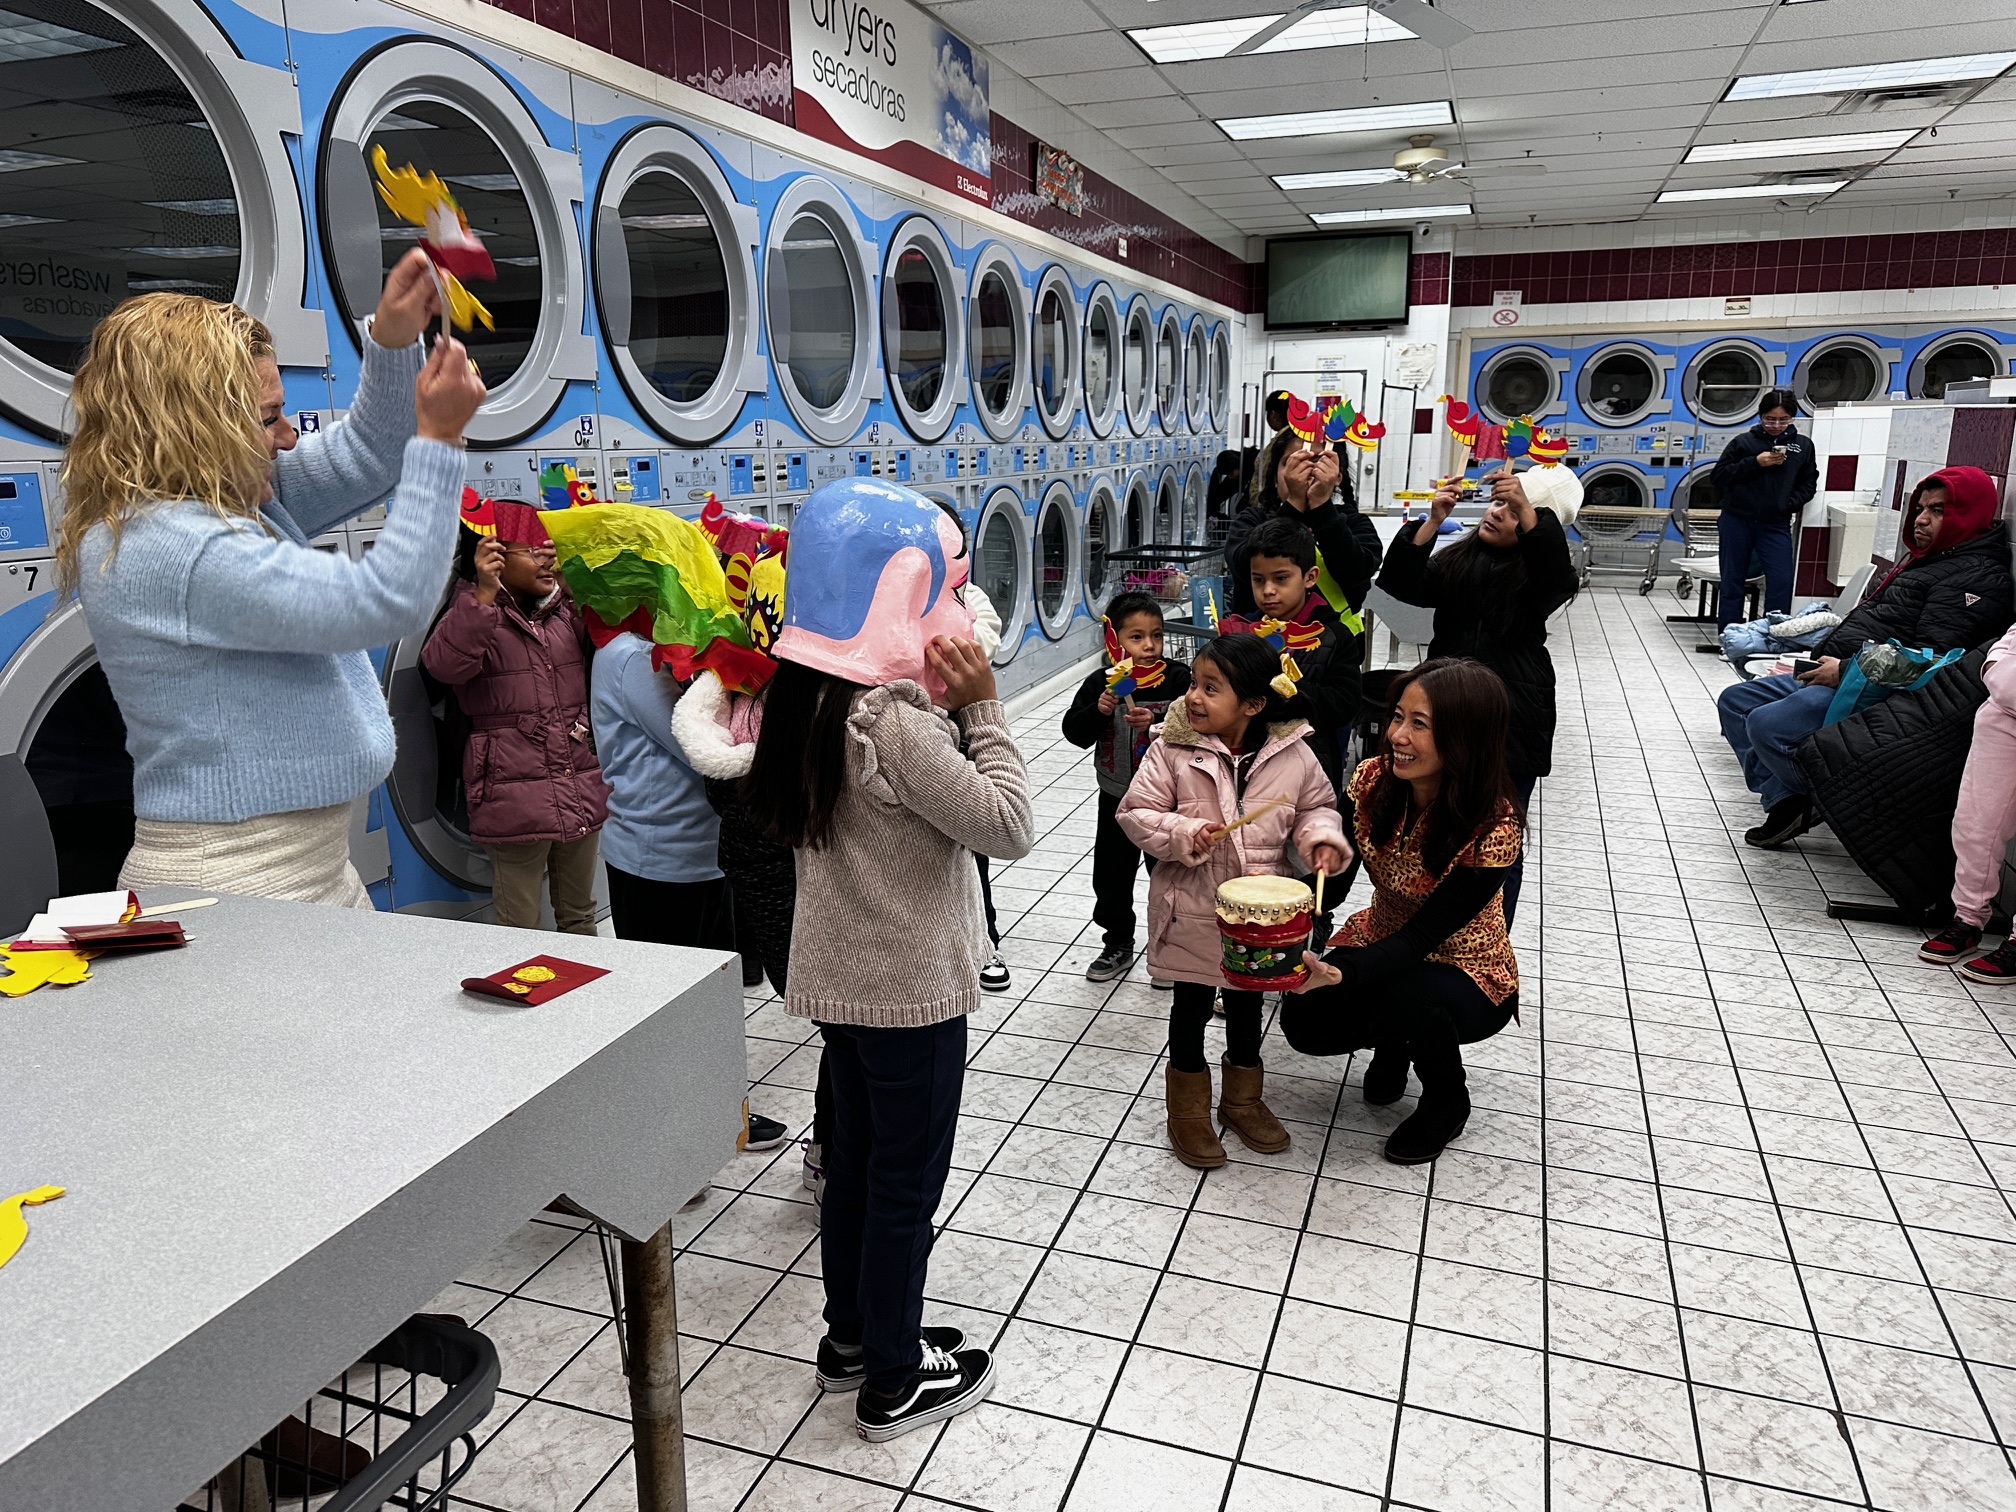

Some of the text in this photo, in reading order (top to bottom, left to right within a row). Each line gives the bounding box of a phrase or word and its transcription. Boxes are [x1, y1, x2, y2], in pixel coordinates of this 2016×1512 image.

[812, 49, 906, 123] secadoras
[963, 177, 988, 201] Electrolux
[23, 566, 39, 592] 7
